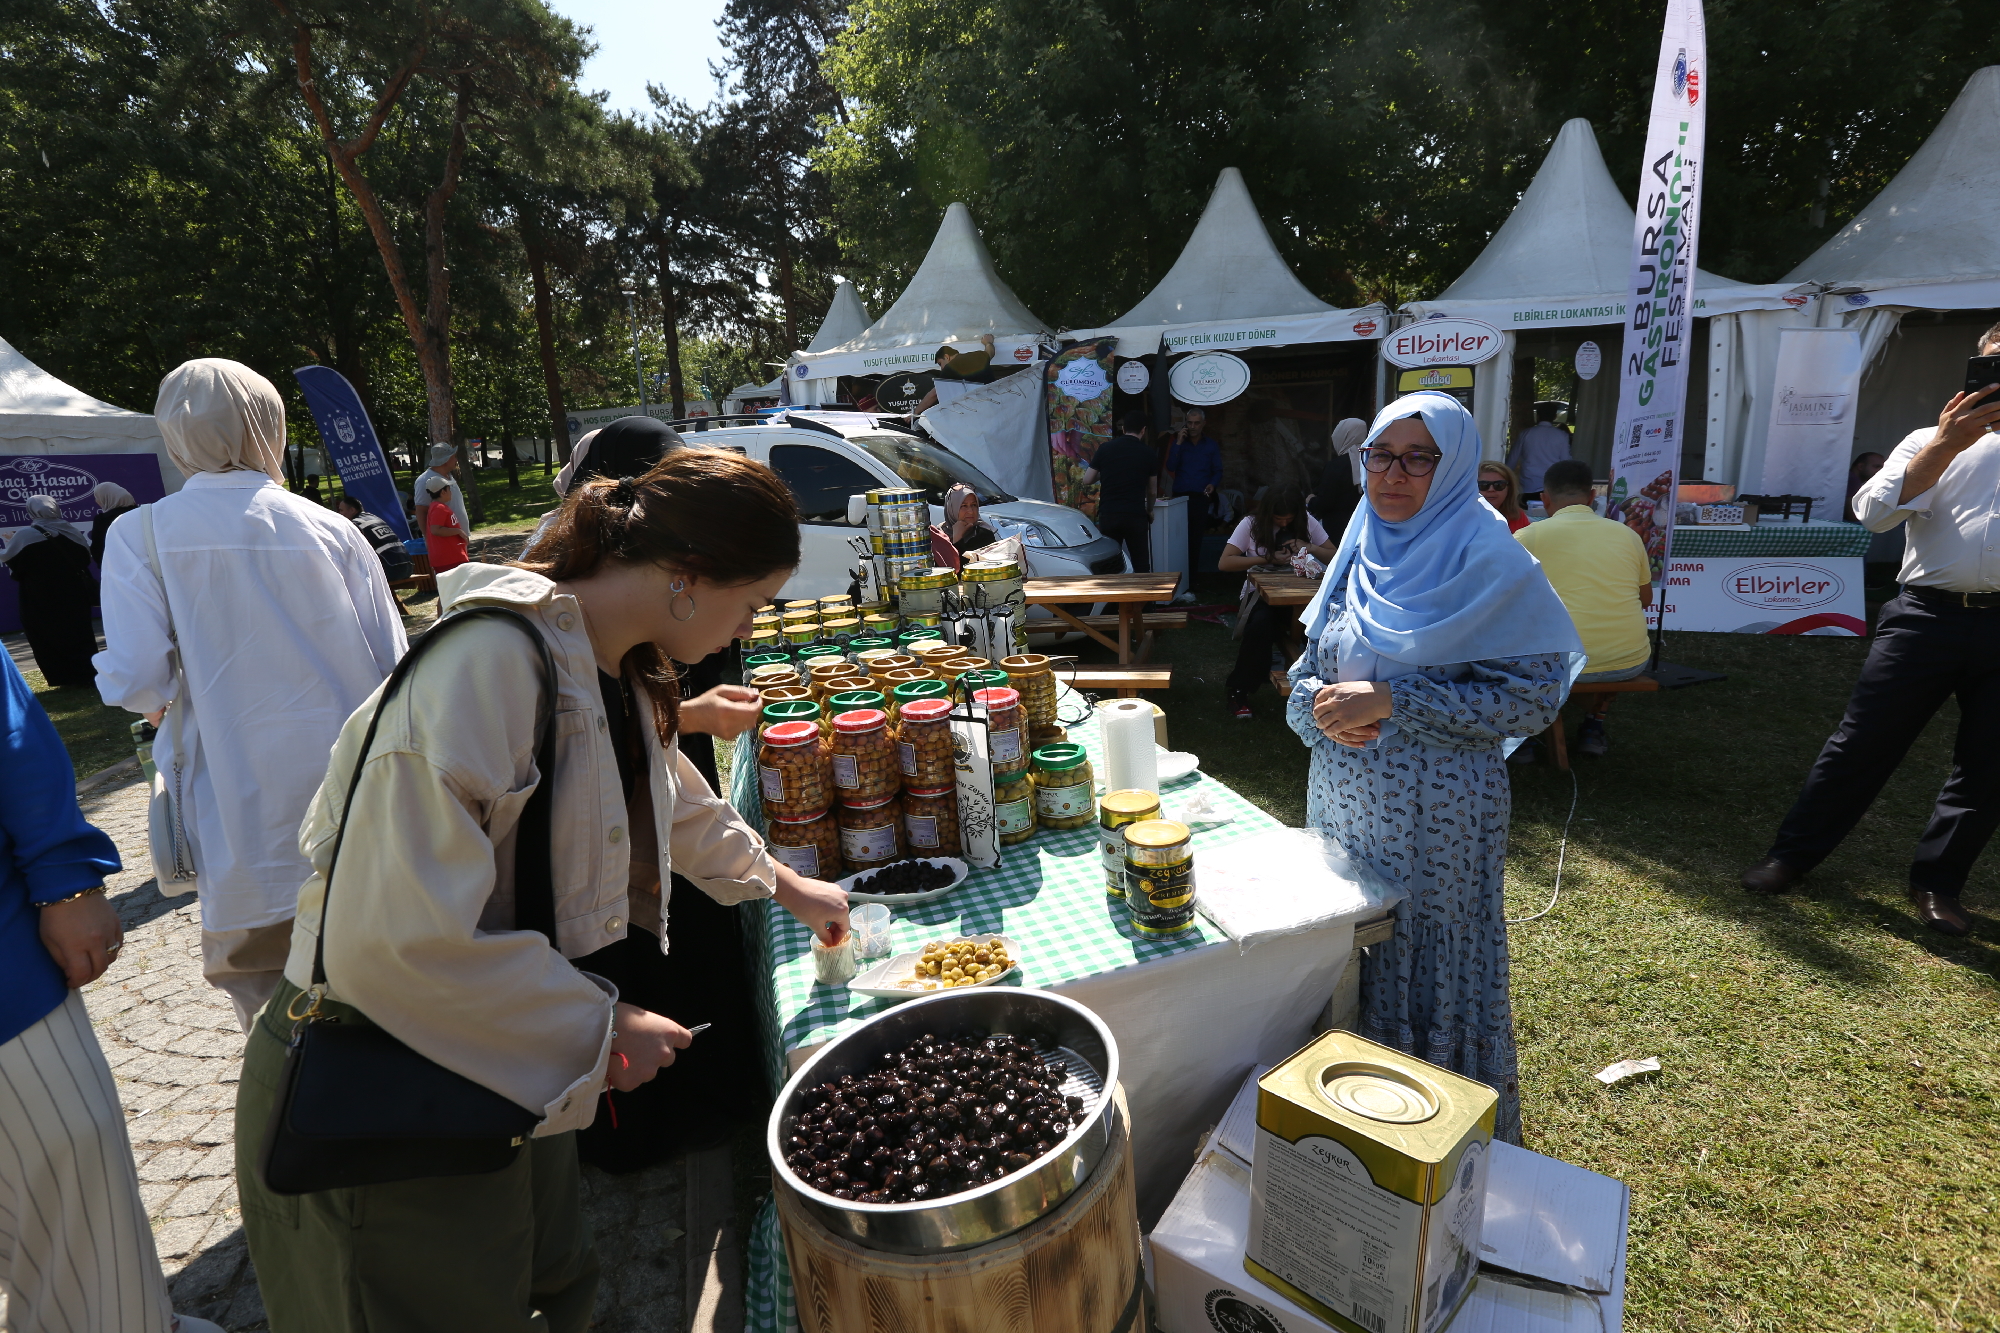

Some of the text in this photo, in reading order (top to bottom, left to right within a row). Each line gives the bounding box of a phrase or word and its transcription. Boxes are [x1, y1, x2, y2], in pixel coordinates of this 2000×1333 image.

[1513, 308, 1558, 322] ELBİRLER
[1560, 306, 1613, 320] LOKANTASI
[1616, 304, 1626, 316] İK
[1164, 328, 1276, 346] YUSUF ÇELİK KUZU ET DÖNER
[1396, 332, 1489, 355] Elbirler
[863, 358, 883, 368] YUSUF
[884, 354, 902, 367] ÇELİK
[903, 354, 920, 364] KUZU
[1789, 402, 1834, 412] JASMINE
[336, 451, 376, 468] BURSA
[340, 460, 379, 475] BÜYÜKŞEHİR
[29, 474, 89, 487] Hasan
[344, 468, 382, 482] BELEDİYESİ
[1735, 576, 1831, 594] Elbirler
[968, 784, 990, 806] Zeykur
[1156, 887, 1190, 898] PREMIUM
